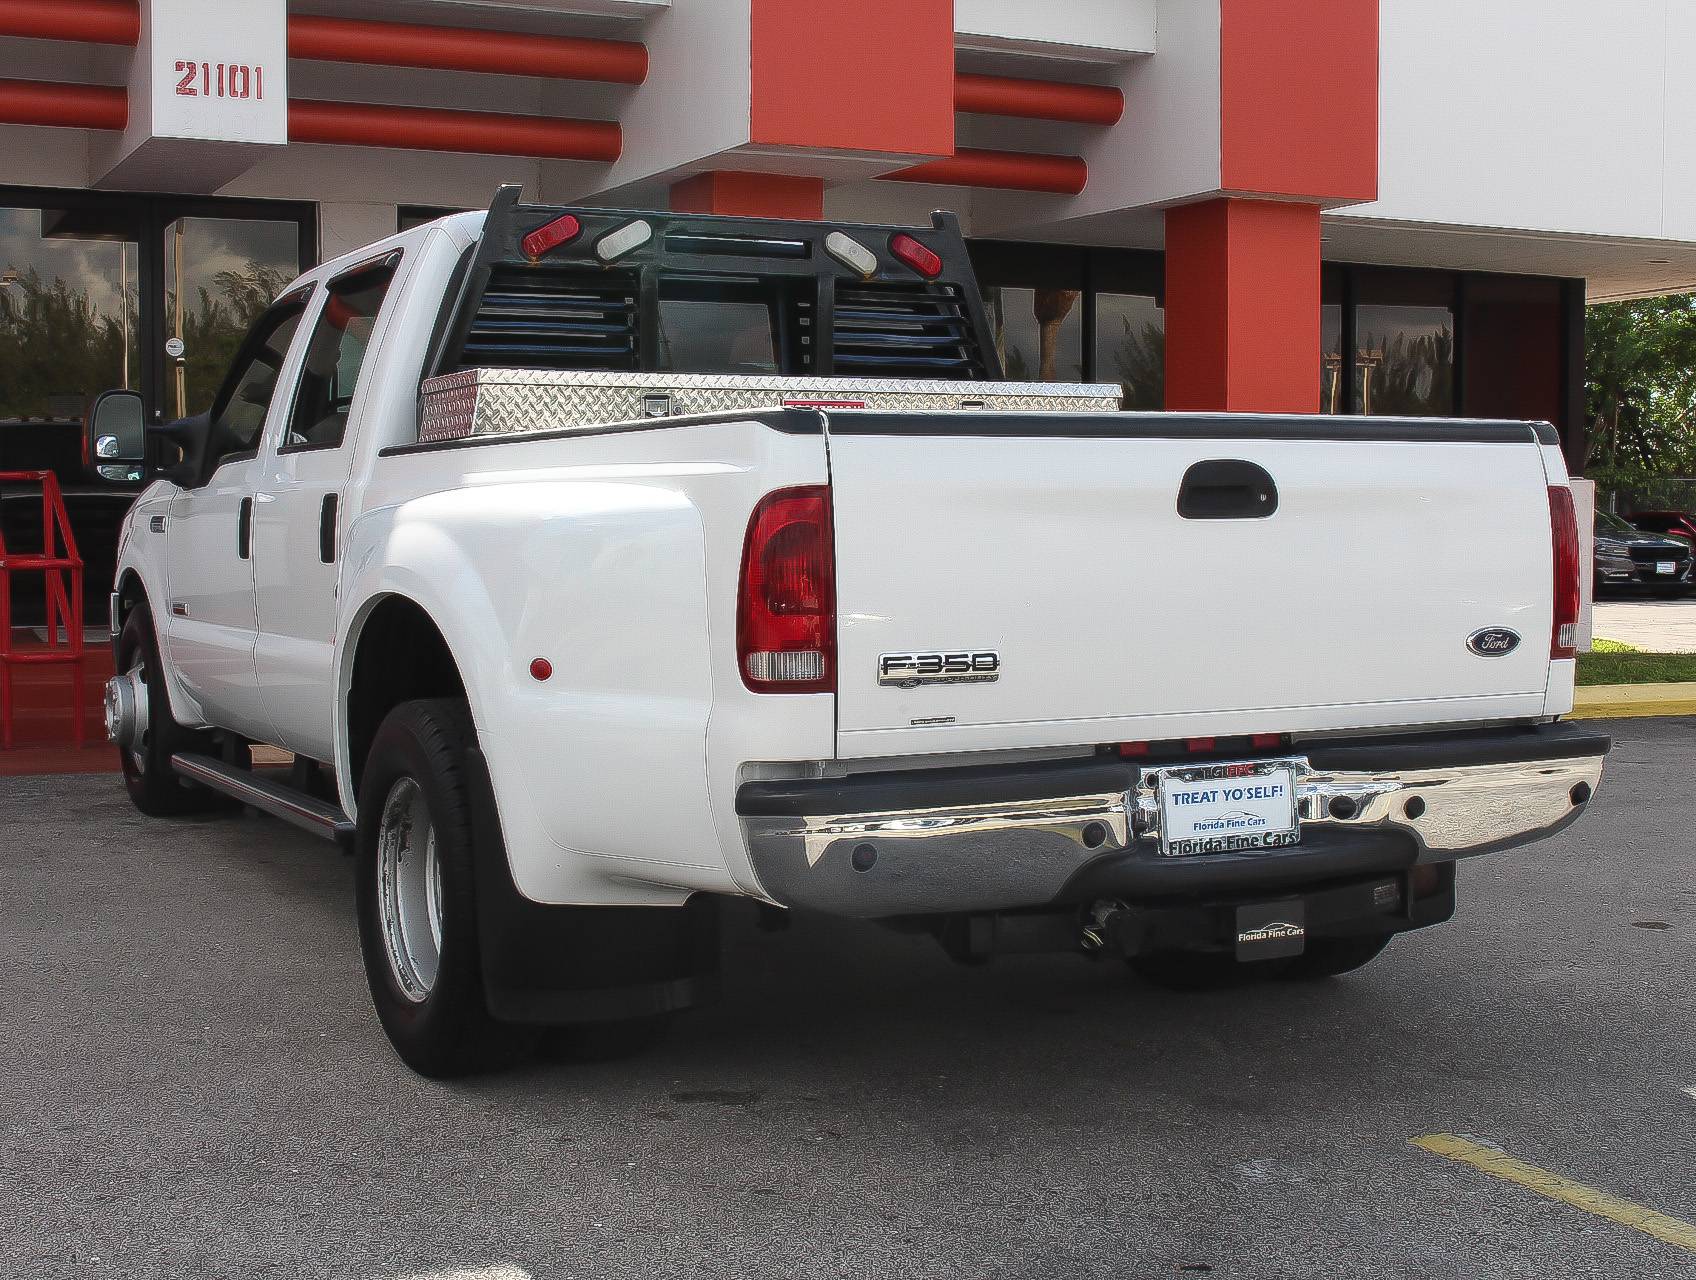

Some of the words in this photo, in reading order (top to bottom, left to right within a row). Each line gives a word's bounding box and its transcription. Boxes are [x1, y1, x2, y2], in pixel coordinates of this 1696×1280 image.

[175, 61, 263, 100] 21101
[1482, 633, 1510, 649] Ford
[881, 652, 999, 676] F-350
[1172, 790, 1218, 806] TREAT
[1221, 785, 1284, 801] YO'SELF!
[1193, 820, 1225, 832] Florida
[1226, 819, 1246, 829] Fine
[1247, 817, 1267, 827] Cars
[1168, 837, 1223, 855] Florida
[1226, 834, 1260, 851] Fine
[1262, 831, 1297, 847] Cars
[1238, 931, 1267, 942] Florida
[1268, 929, 1286, 939] Fine
[1287, 927, 1305, 936] Cars
